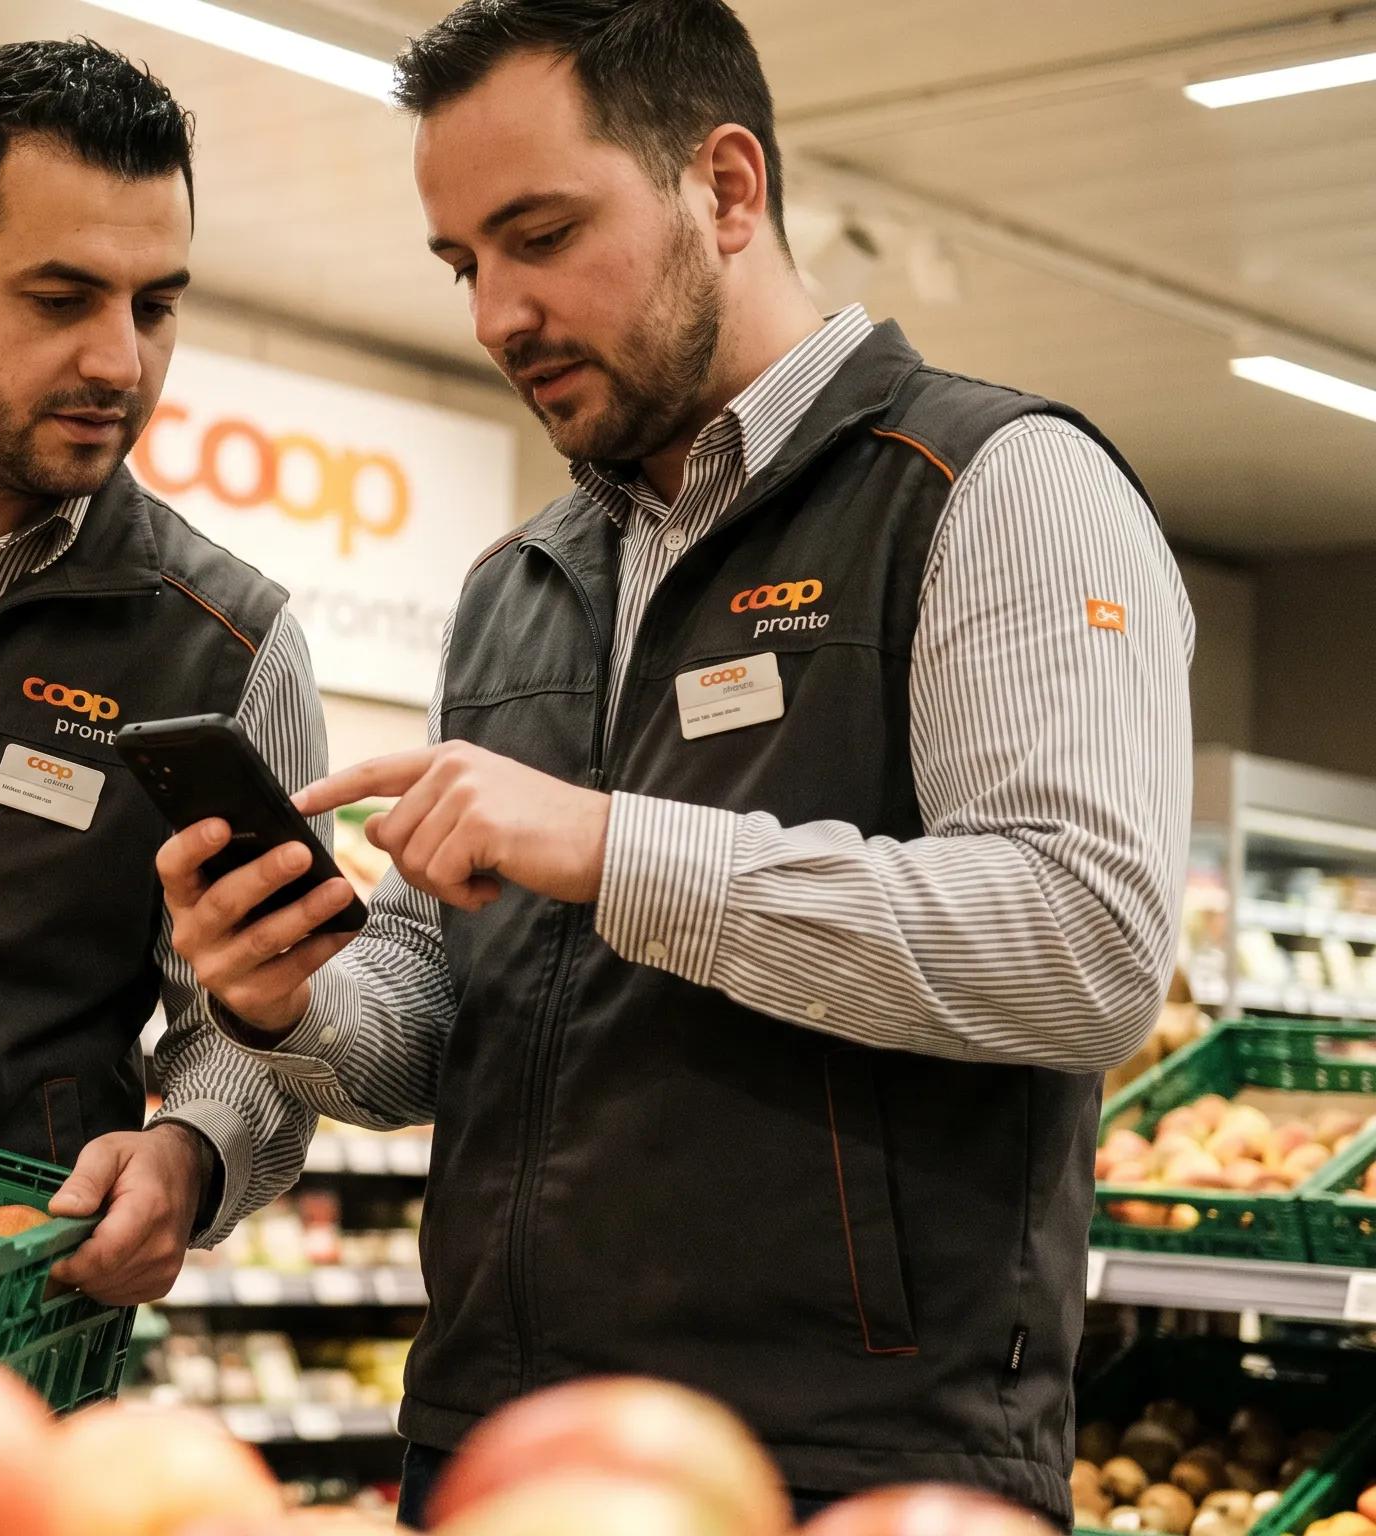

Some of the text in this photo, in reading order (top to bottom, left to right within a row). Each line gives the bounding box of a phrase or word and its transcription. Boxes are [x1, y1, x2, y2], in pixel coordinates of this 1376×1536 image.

[132, 404, 411, 556] coop
[730, 578, 823, 613] coop
[753, 611, 830, 638] pronto
[700, 666, 747, 688] coop
[22, 676, 120, 722] coop
[54, 717, 117, 745] pront
[27, 756, 73, 779] coop
